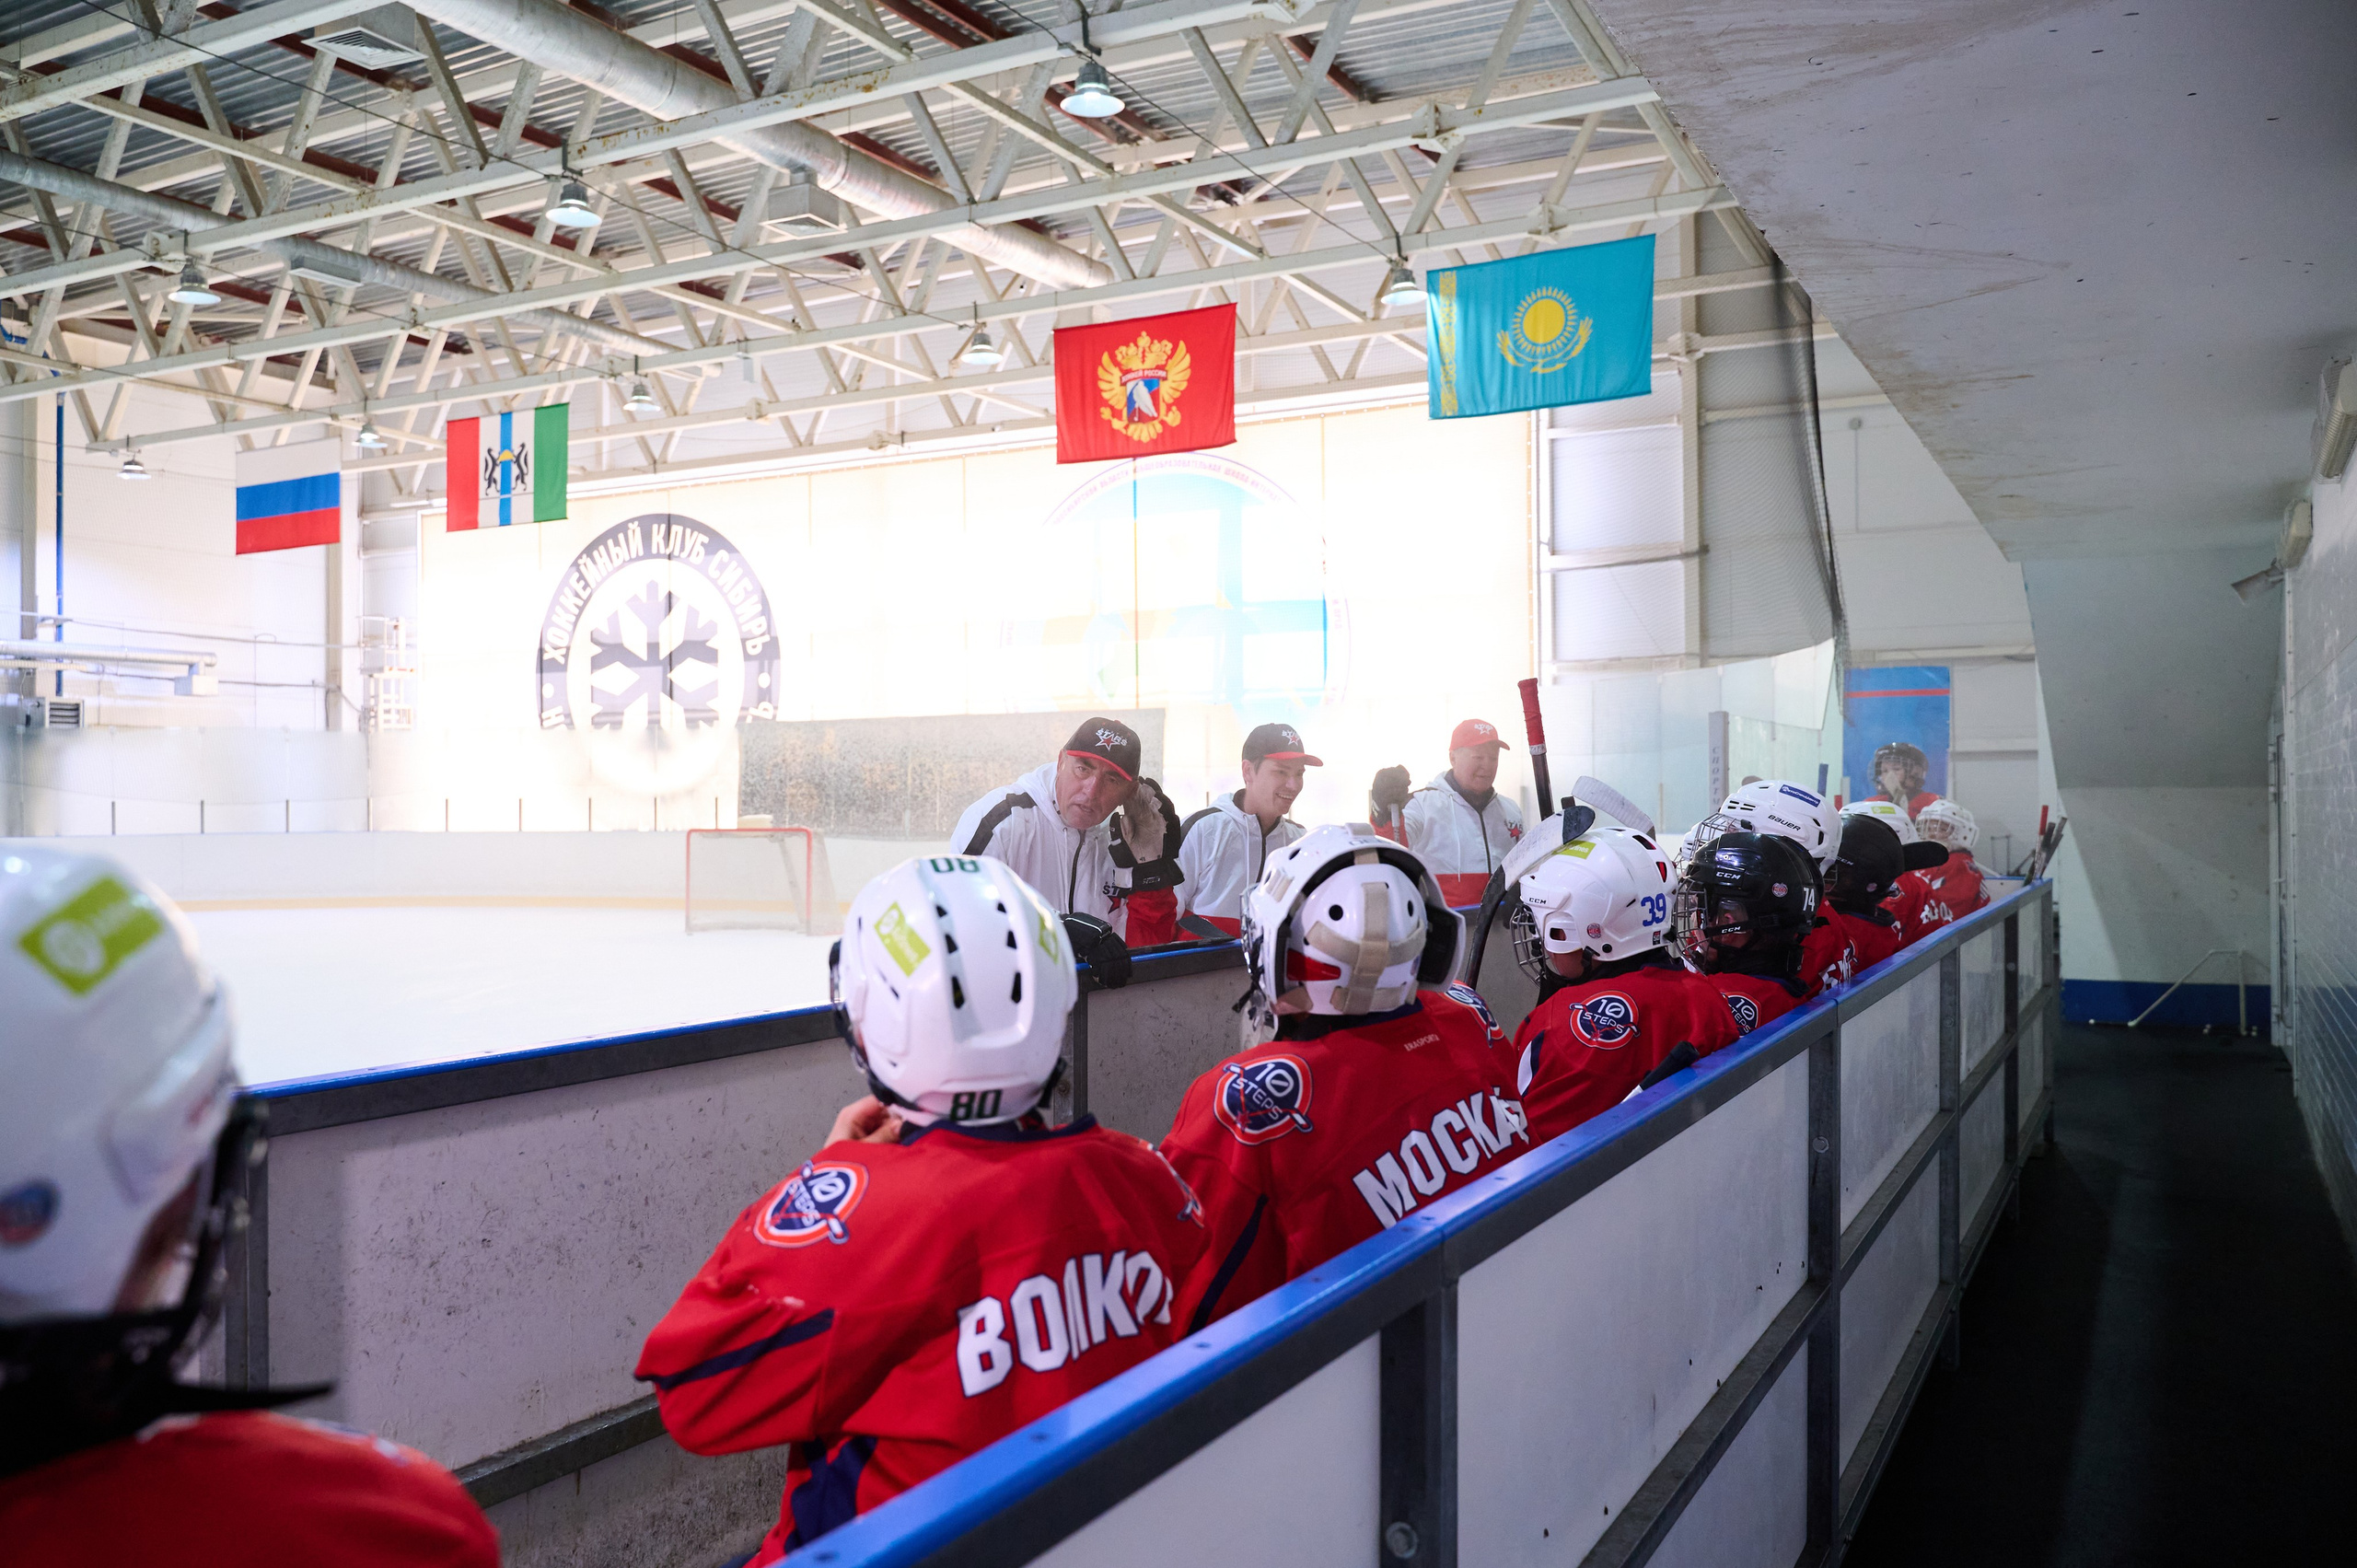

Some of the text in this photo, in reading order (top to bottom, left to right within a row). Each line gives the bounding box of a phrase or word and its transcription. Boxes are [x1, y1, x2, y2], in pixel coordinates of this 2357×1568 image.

[543, 520, 771, 665] ХОККЕЙНЫЙ КЛУБ СИБИРЬ
[1768, 814, 1802, 831] BAUER
[1715, 871, 1741, 880] CCM
[1528, 897, 1547, 905] CCM
[1640, 892, 1666, 927] 39
[1803, 888, 1816, 912] 74
[1583, 1011, 1624, 1034] STEPS
[1597, 999, 1625, 1018] 10
[1728, 1004, 1751, 1033] TEPS
[1736, 998, 1755, 1021] 10
[1255, 1063, 1295, 1098] 10
[950, 1088, 1004, 1121] 80
[1232, 1077, 1283, 1121] STEPS
[807, 1170, 846, 1203] 10
[787, 1179, 822, 1227] STEPS
